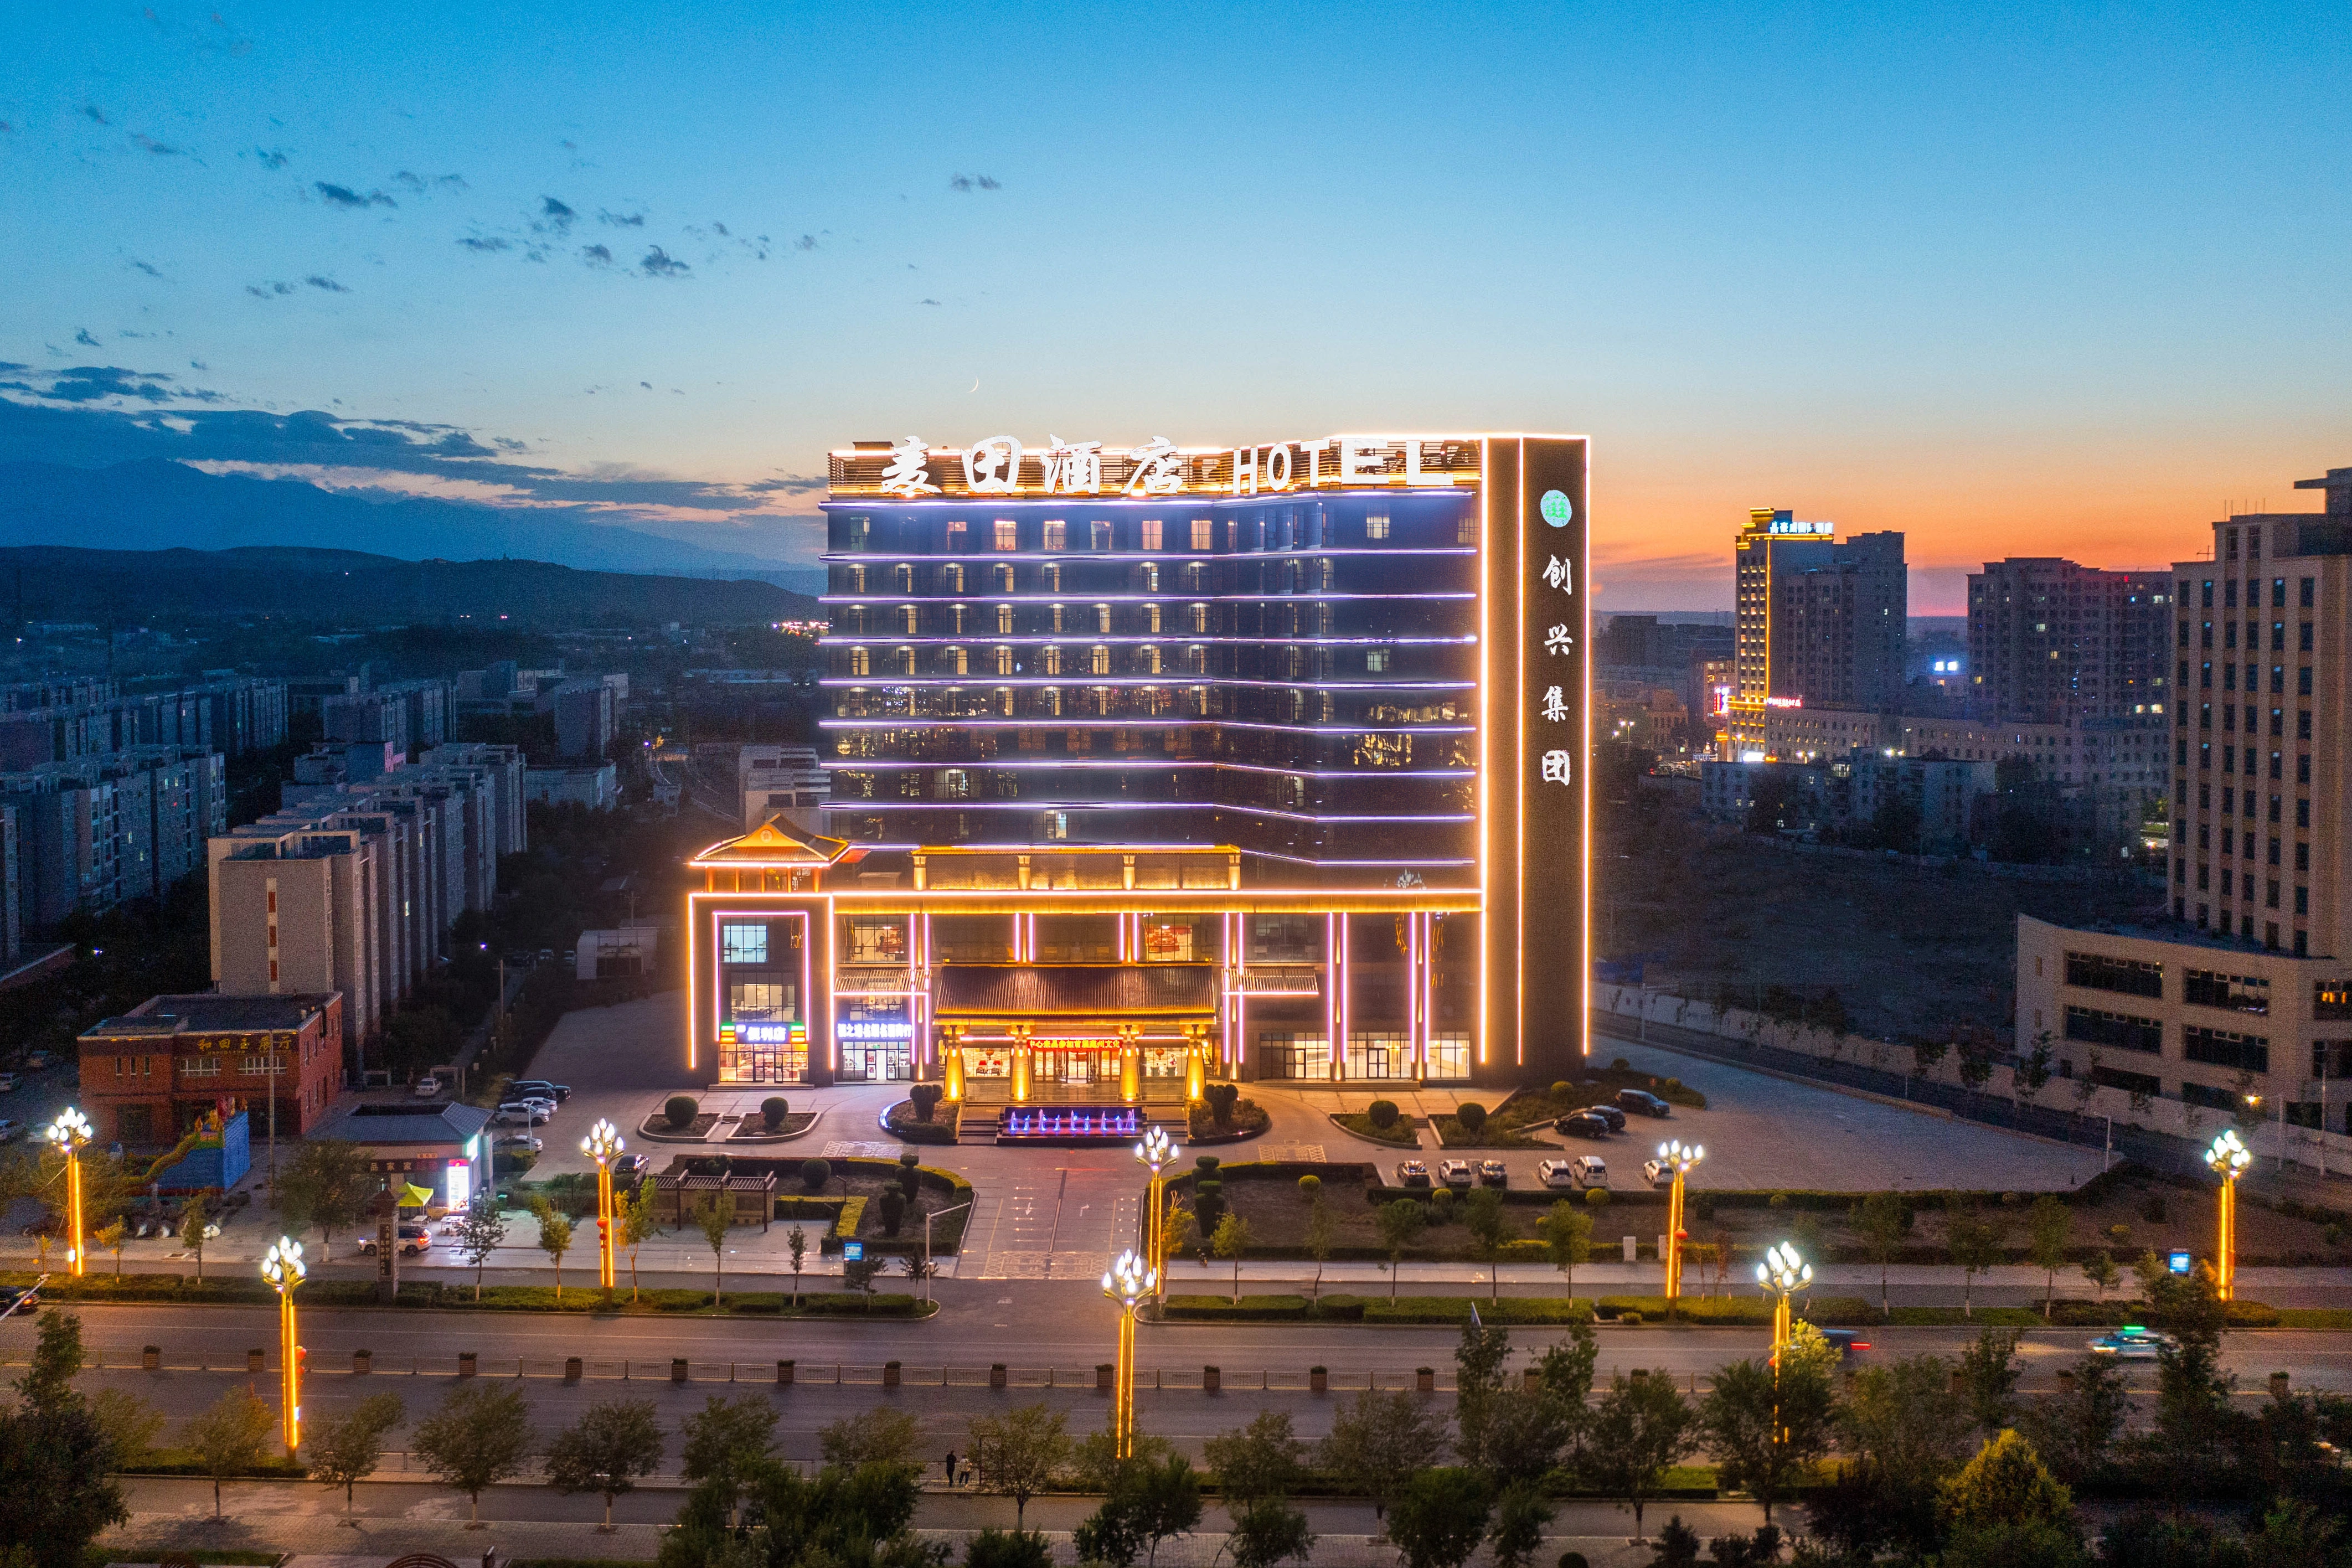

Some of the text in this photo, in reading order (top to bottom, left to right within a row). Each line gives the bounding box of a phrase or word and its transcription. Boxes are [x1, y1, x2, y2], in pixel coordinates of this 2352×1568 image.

[881, 433, 1183, 494] 麦田酒店
[1233, 439, 1454, 494] HOTEL
[1542, 554, 1573, 786] 创兴集团
